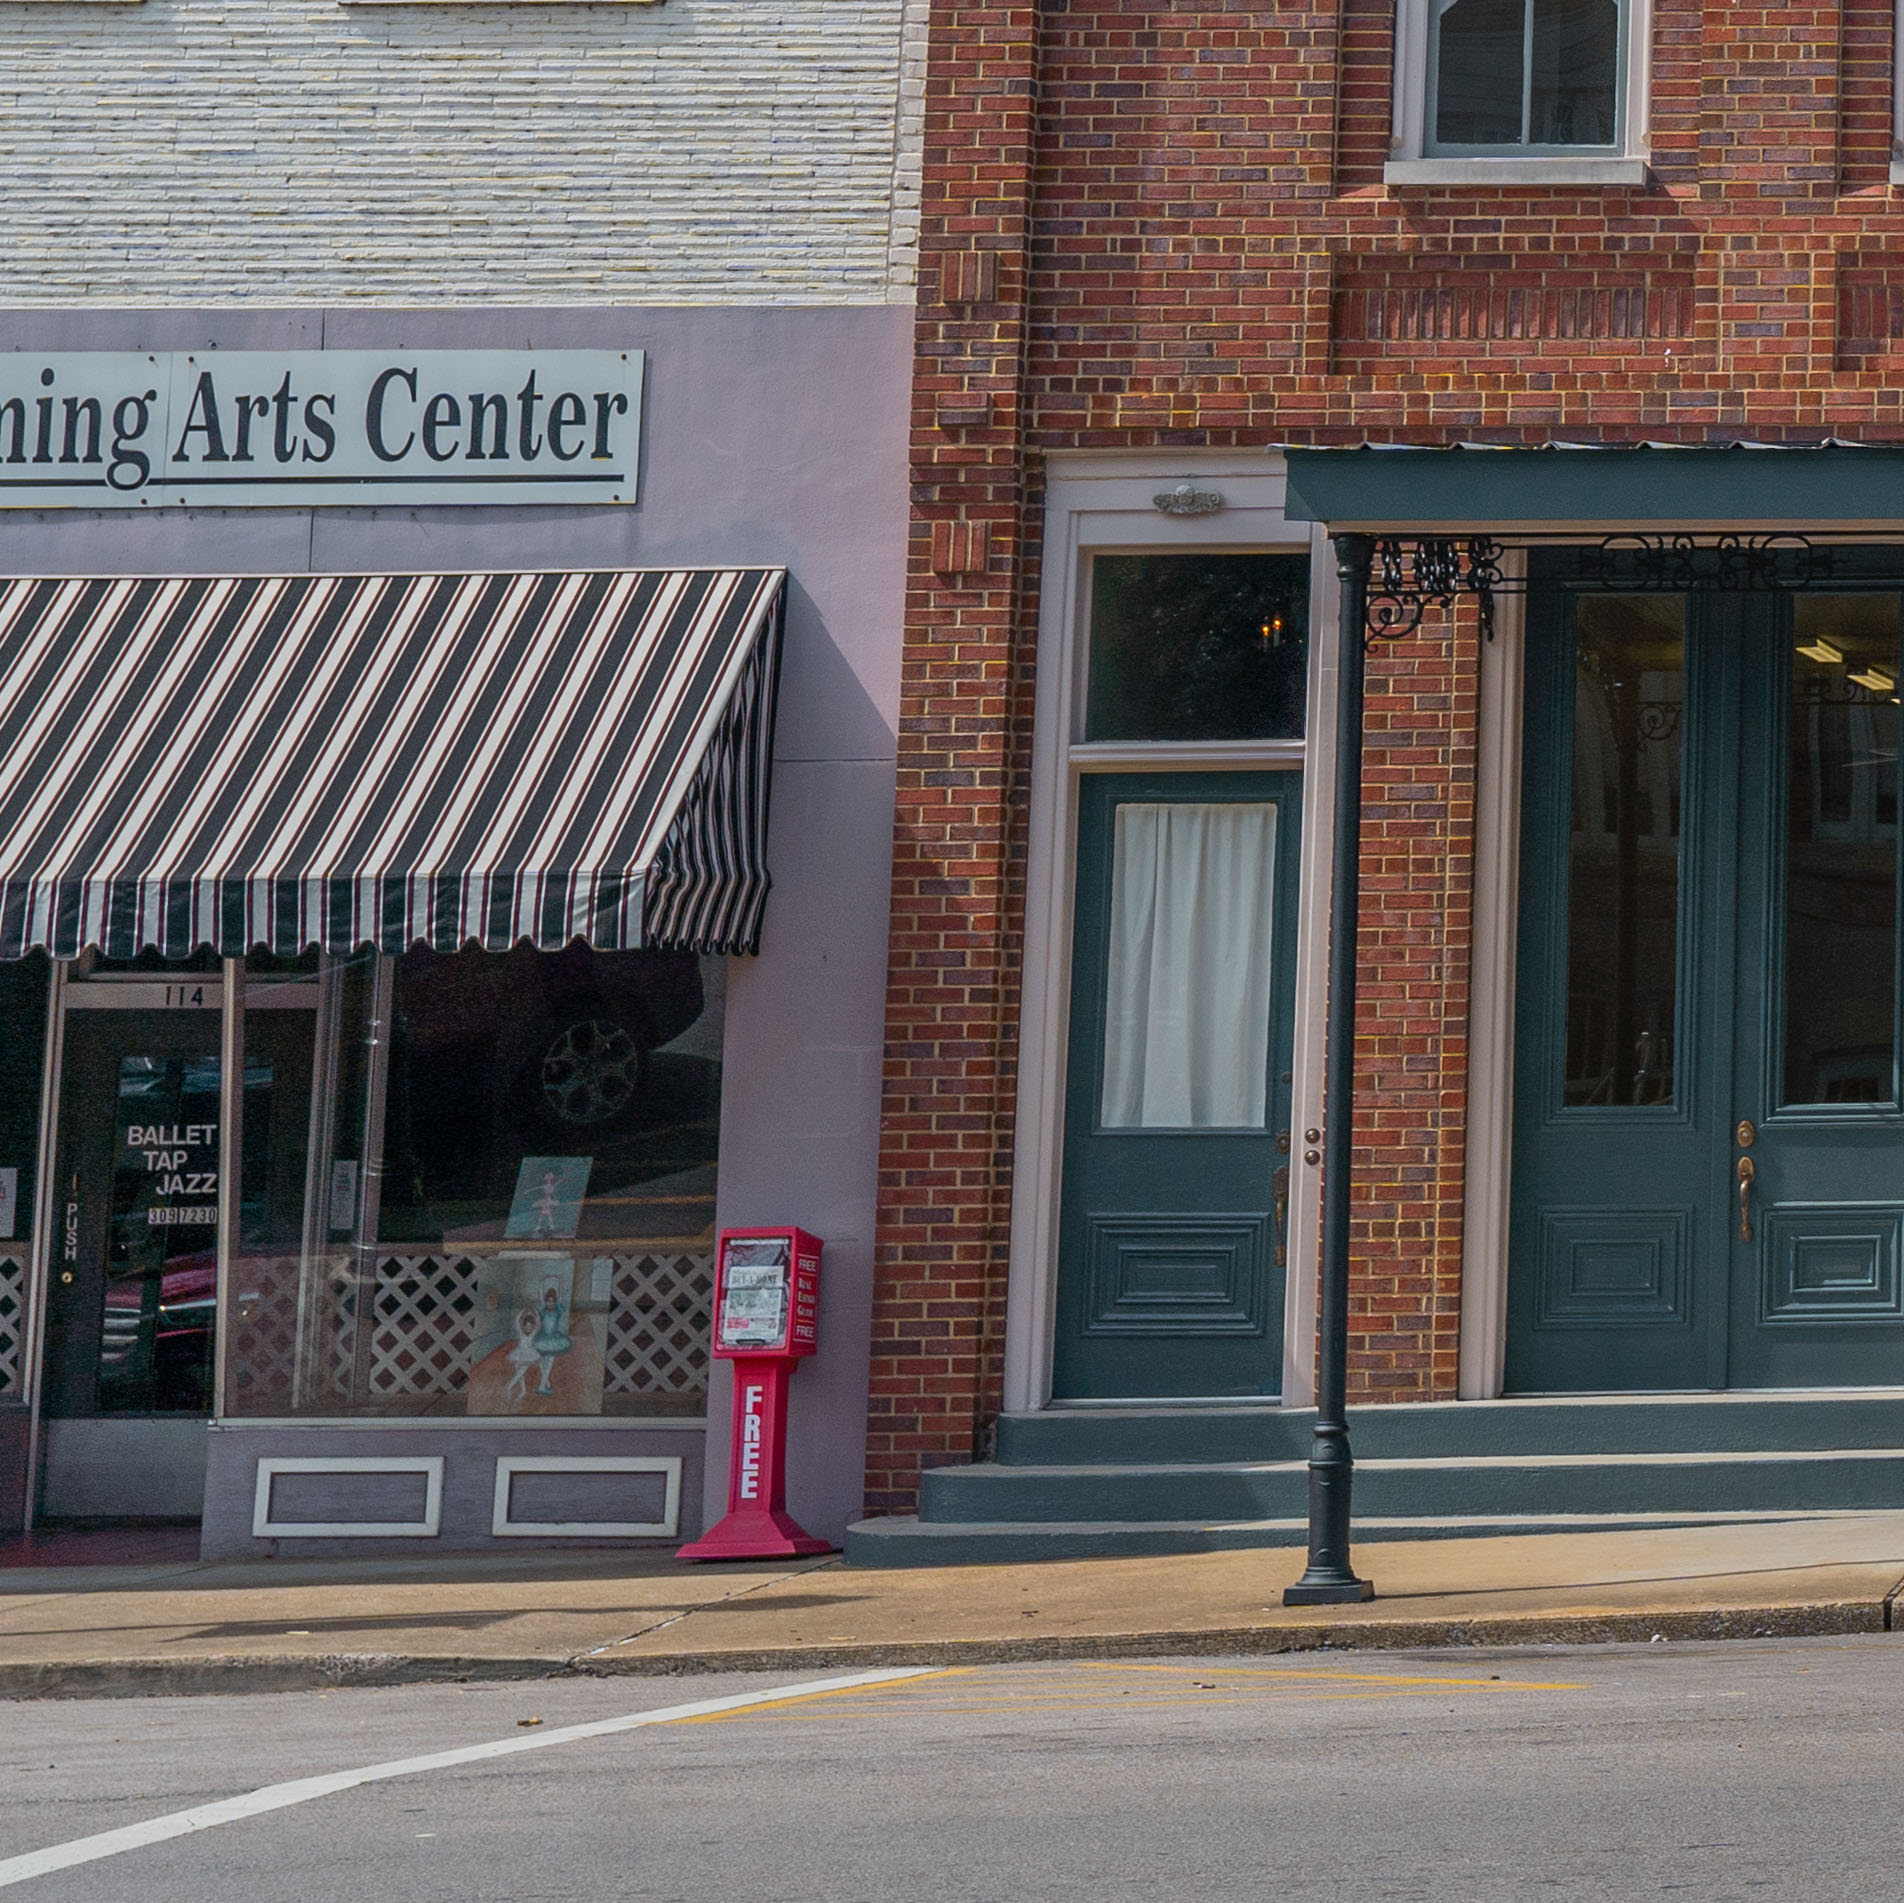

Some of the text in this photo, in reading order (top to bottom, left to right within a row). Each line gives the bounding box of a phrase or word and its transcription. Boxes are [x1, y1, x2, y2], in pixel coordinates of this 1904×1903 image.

[172, 370, 336, 463] Arts
[365, 366, 628, 463] Center
[165, 985, 204, 1006] 114
[127, 1124, 217, 1146] BALLET
[142, 1150, 188, 1171] TAP
[156, 1172, 217, 1196] JAZZ
[64, 1202, 78, 1261] PUSH
[798, 1258, 817, 1273] FREE
[796, 1324, 815, 1338] FREE
[741, 1385, 763, 1499] FREE
